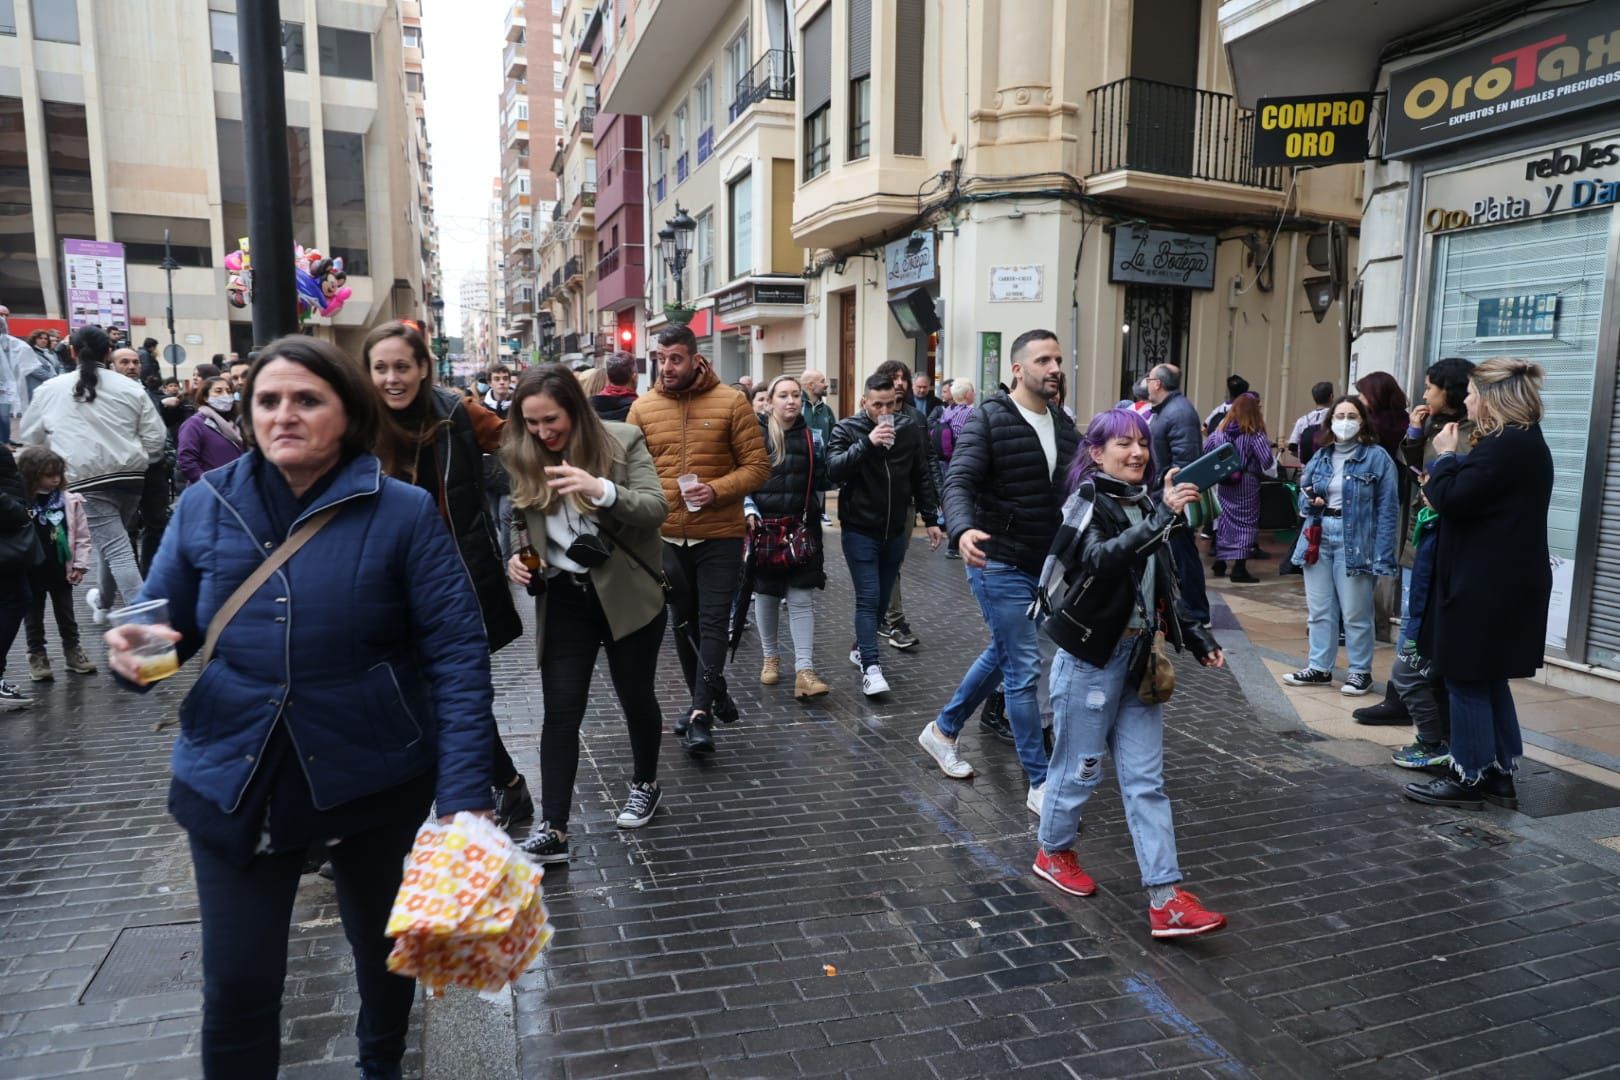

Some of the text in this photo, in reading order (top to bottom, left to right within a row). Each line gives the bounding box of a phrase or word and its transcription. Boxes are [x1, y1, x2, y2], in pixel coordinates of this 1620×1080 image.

[1449, 71, 1620, 126] EXPERTOS EN METALES PRECIOSOS
[1262, 99, 1365, 130] COMPRO
[1285, 131, 1336, 158] ORO
[1471, 196, 1531, 225] Plata
[1120, 234, 1209, 282] La Bodega
